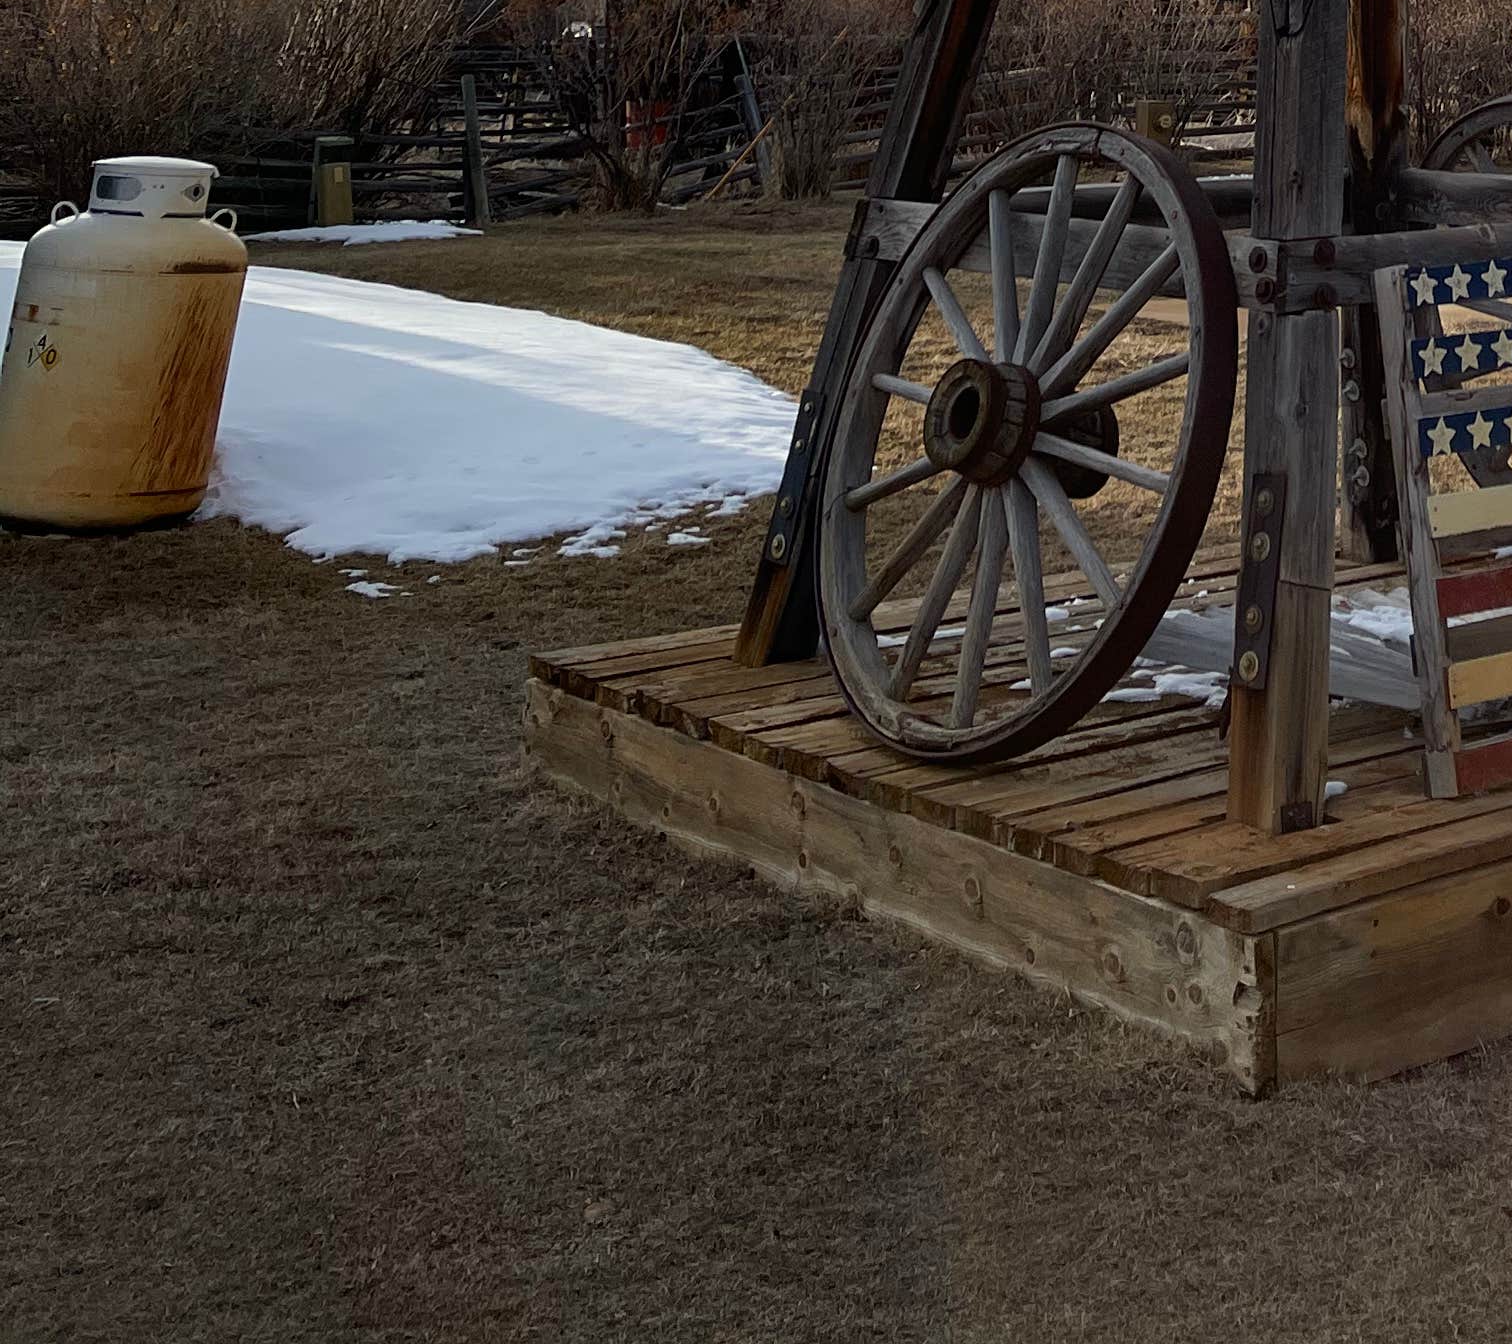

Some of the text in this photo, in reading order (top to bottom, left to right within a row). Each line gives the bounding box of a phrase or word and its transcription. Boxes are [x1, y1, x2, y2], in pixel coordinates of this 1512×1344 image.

[37, 334, 47, 350] 4
[28, 347, 57, 365] 1 0
